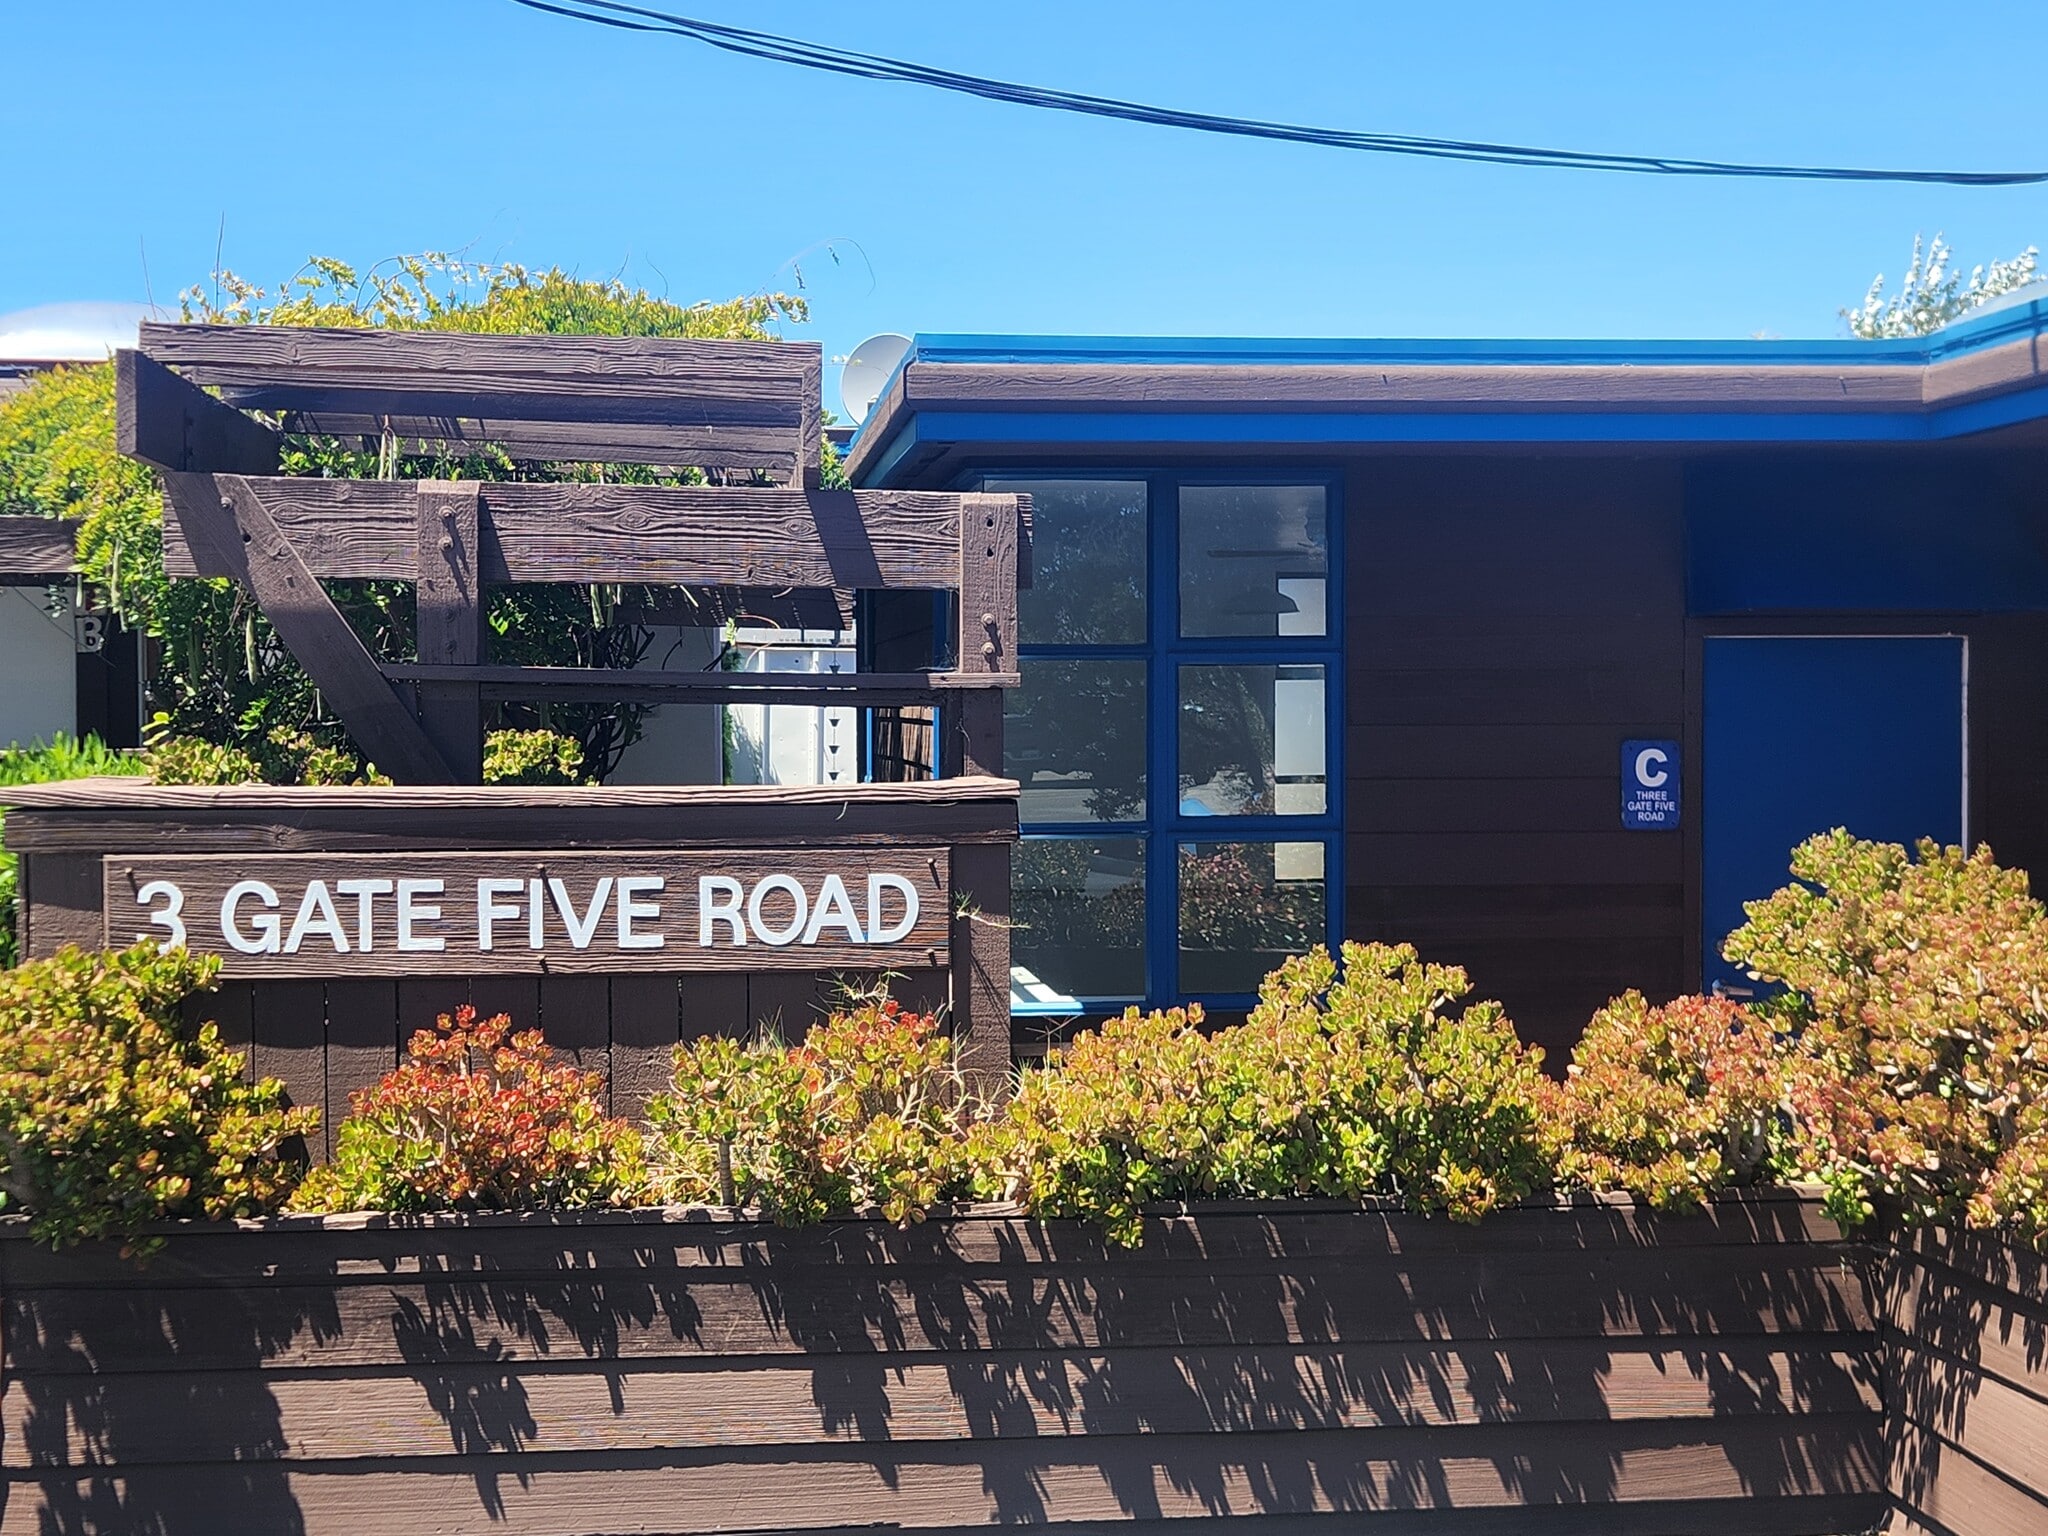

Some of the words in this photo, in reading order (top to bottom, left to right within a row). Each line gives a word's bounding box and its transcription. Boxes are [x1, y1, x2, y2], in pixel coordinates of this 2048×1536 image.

[76, 617, 102, 652] B
[1635, 748, 1668, 787] C
[1627, 801, 1652, 811] GATE
[1655, 801, 1675, 811] FIVE
[1636, 791, 1667, 801] THREE
[1637, 812, 1665, 821] ROAD
[137, 881, 186, 954] 3
[220, 879, 445, 954] GATE
[477, 877, 664, 950] FIVE
[699, 873, 919, 946] ROAD
